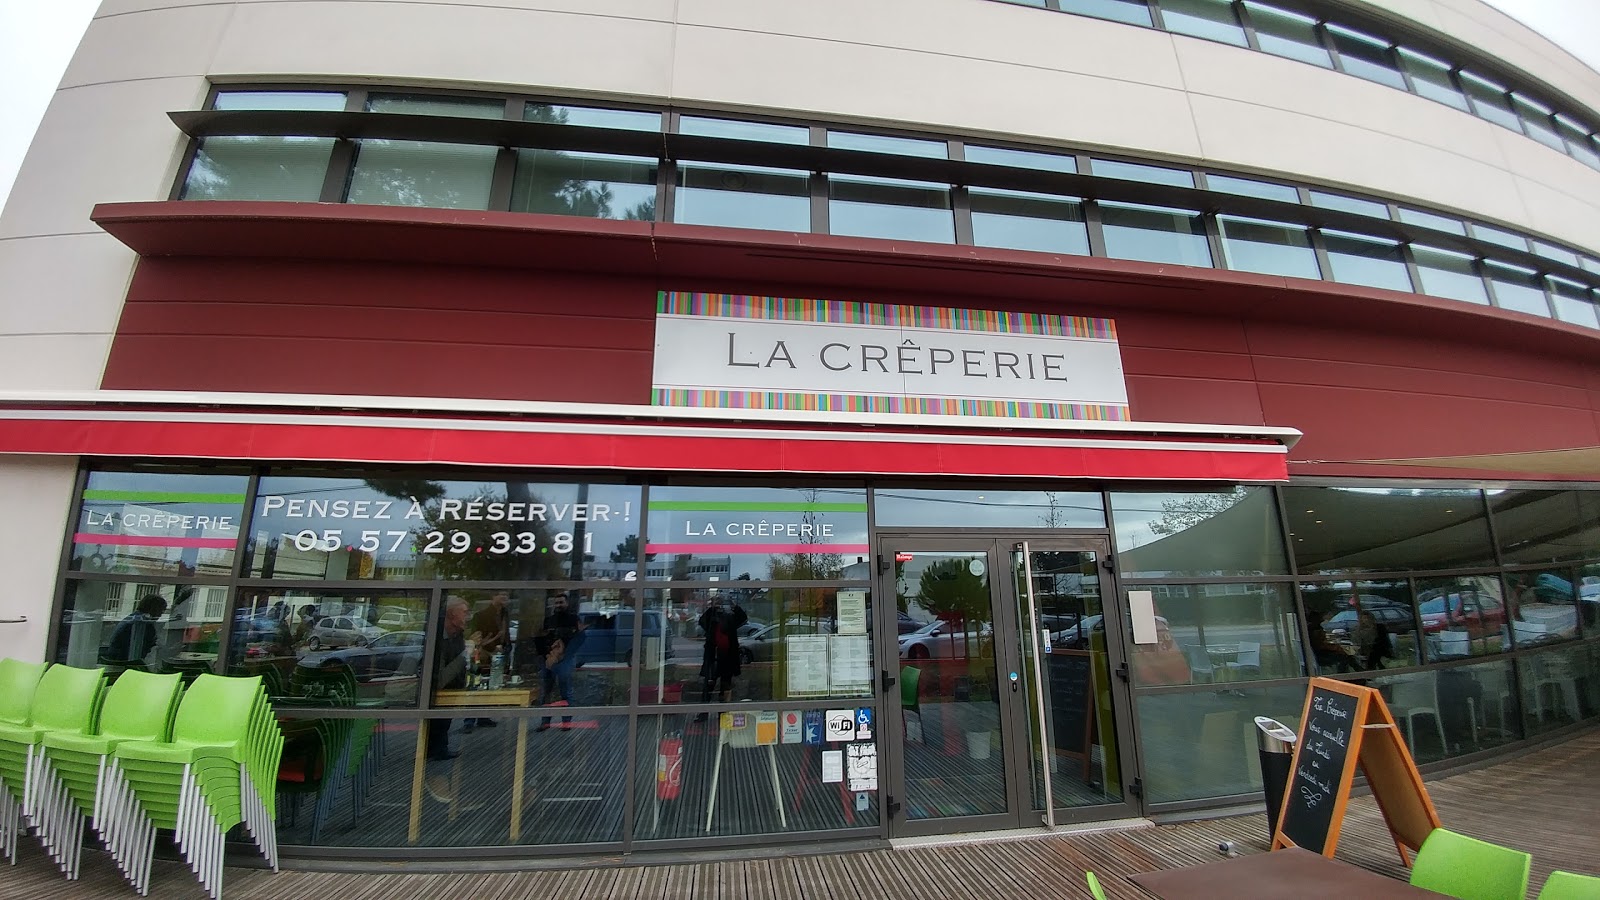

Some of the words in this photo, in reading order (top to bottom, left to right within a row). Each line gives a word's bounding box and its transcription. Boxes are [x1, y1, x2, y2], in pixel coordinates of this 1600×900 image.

[727, 332, 797, 370] LA
[819, 338, 1068, 383] CRÊPERIE
[261, 495, 393, 520] PENSEZ
[404, 495, 425, 520] À
[86, 509, 114, 526] LA
[122, 511, 233, 531] CRÊPERIE
[685, 520, 717, 536] LA
[725, 519, 834, 537] CRÊPERIE
